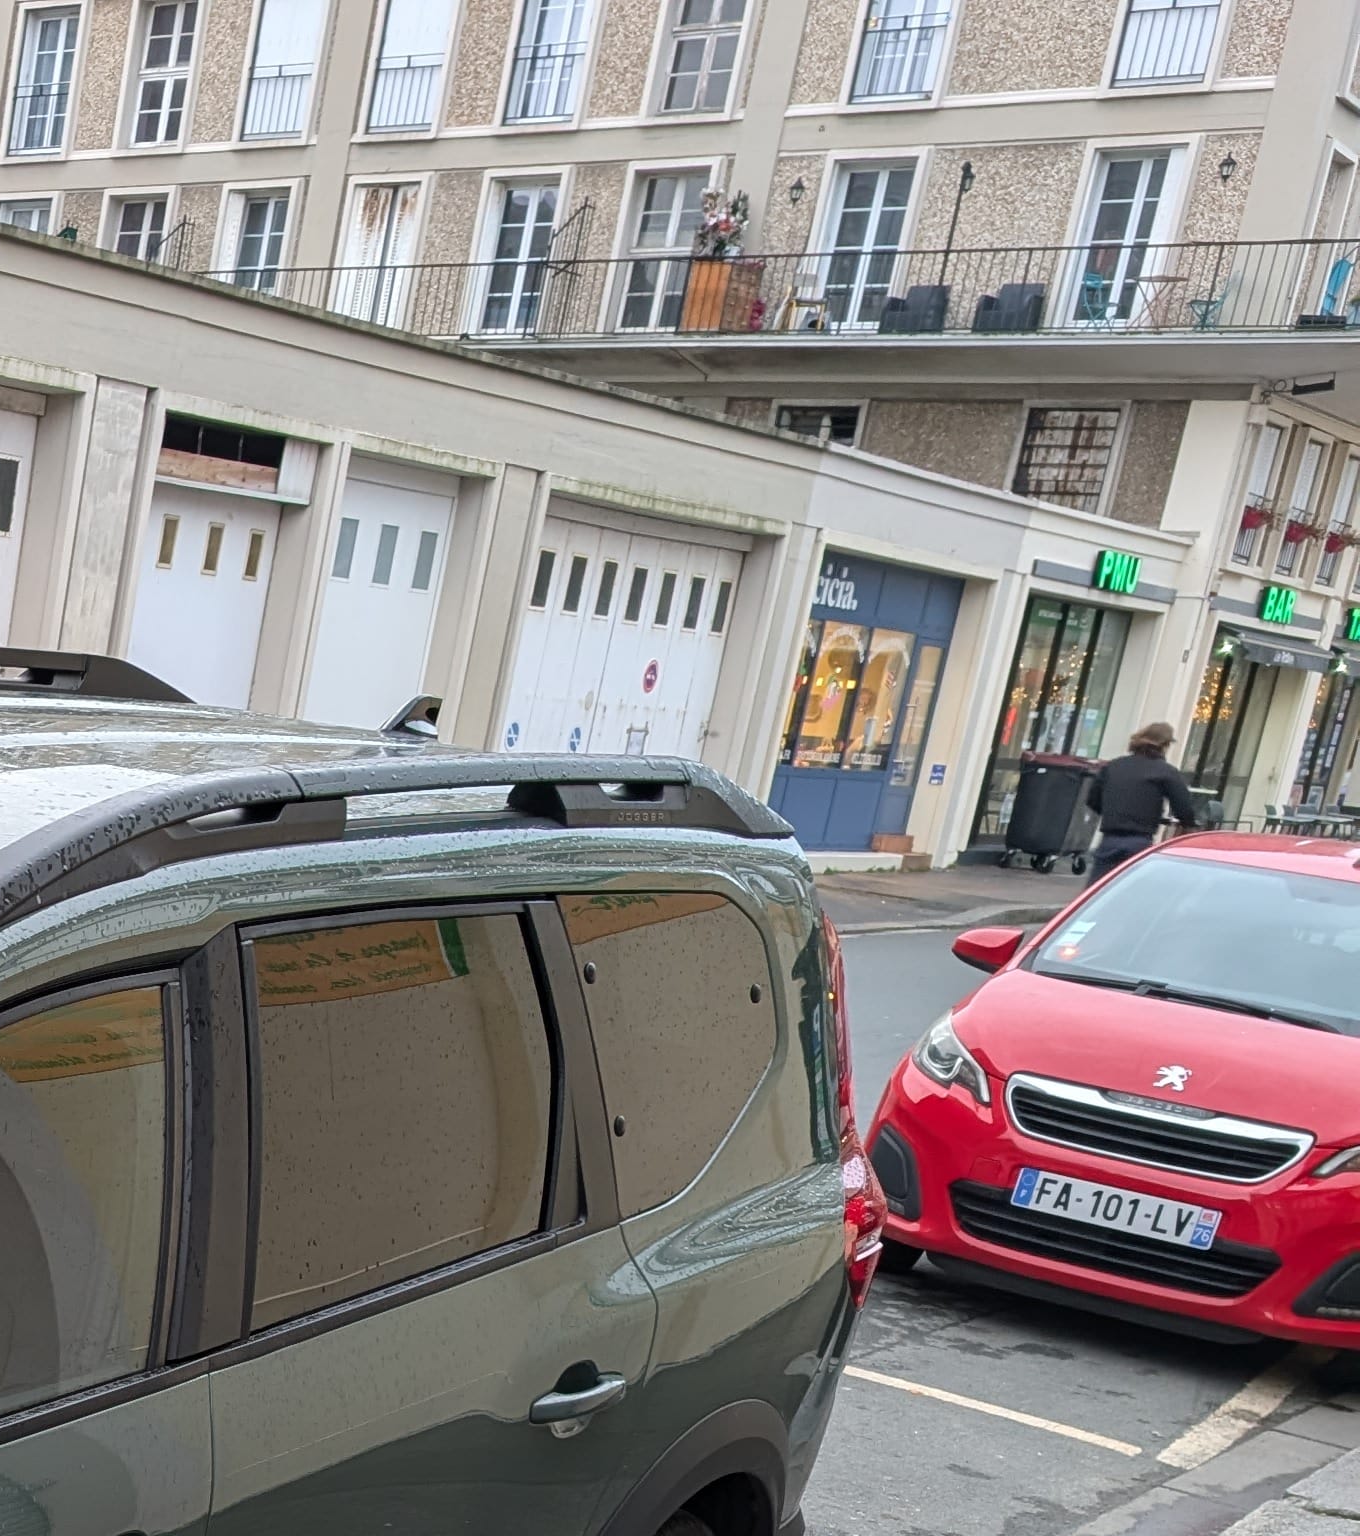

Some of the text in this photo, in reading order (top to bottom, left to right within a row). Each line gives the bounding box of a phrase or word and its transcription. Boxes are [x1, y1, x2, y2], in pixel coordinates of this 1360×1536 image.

[1098, 549, 1142, 594] PMU
[1263, 586, 1297, 625] BAR
[1034, 1177, 1194, 1238] FA-101-LV
[1192, 1227, 1211, 1243] 76
